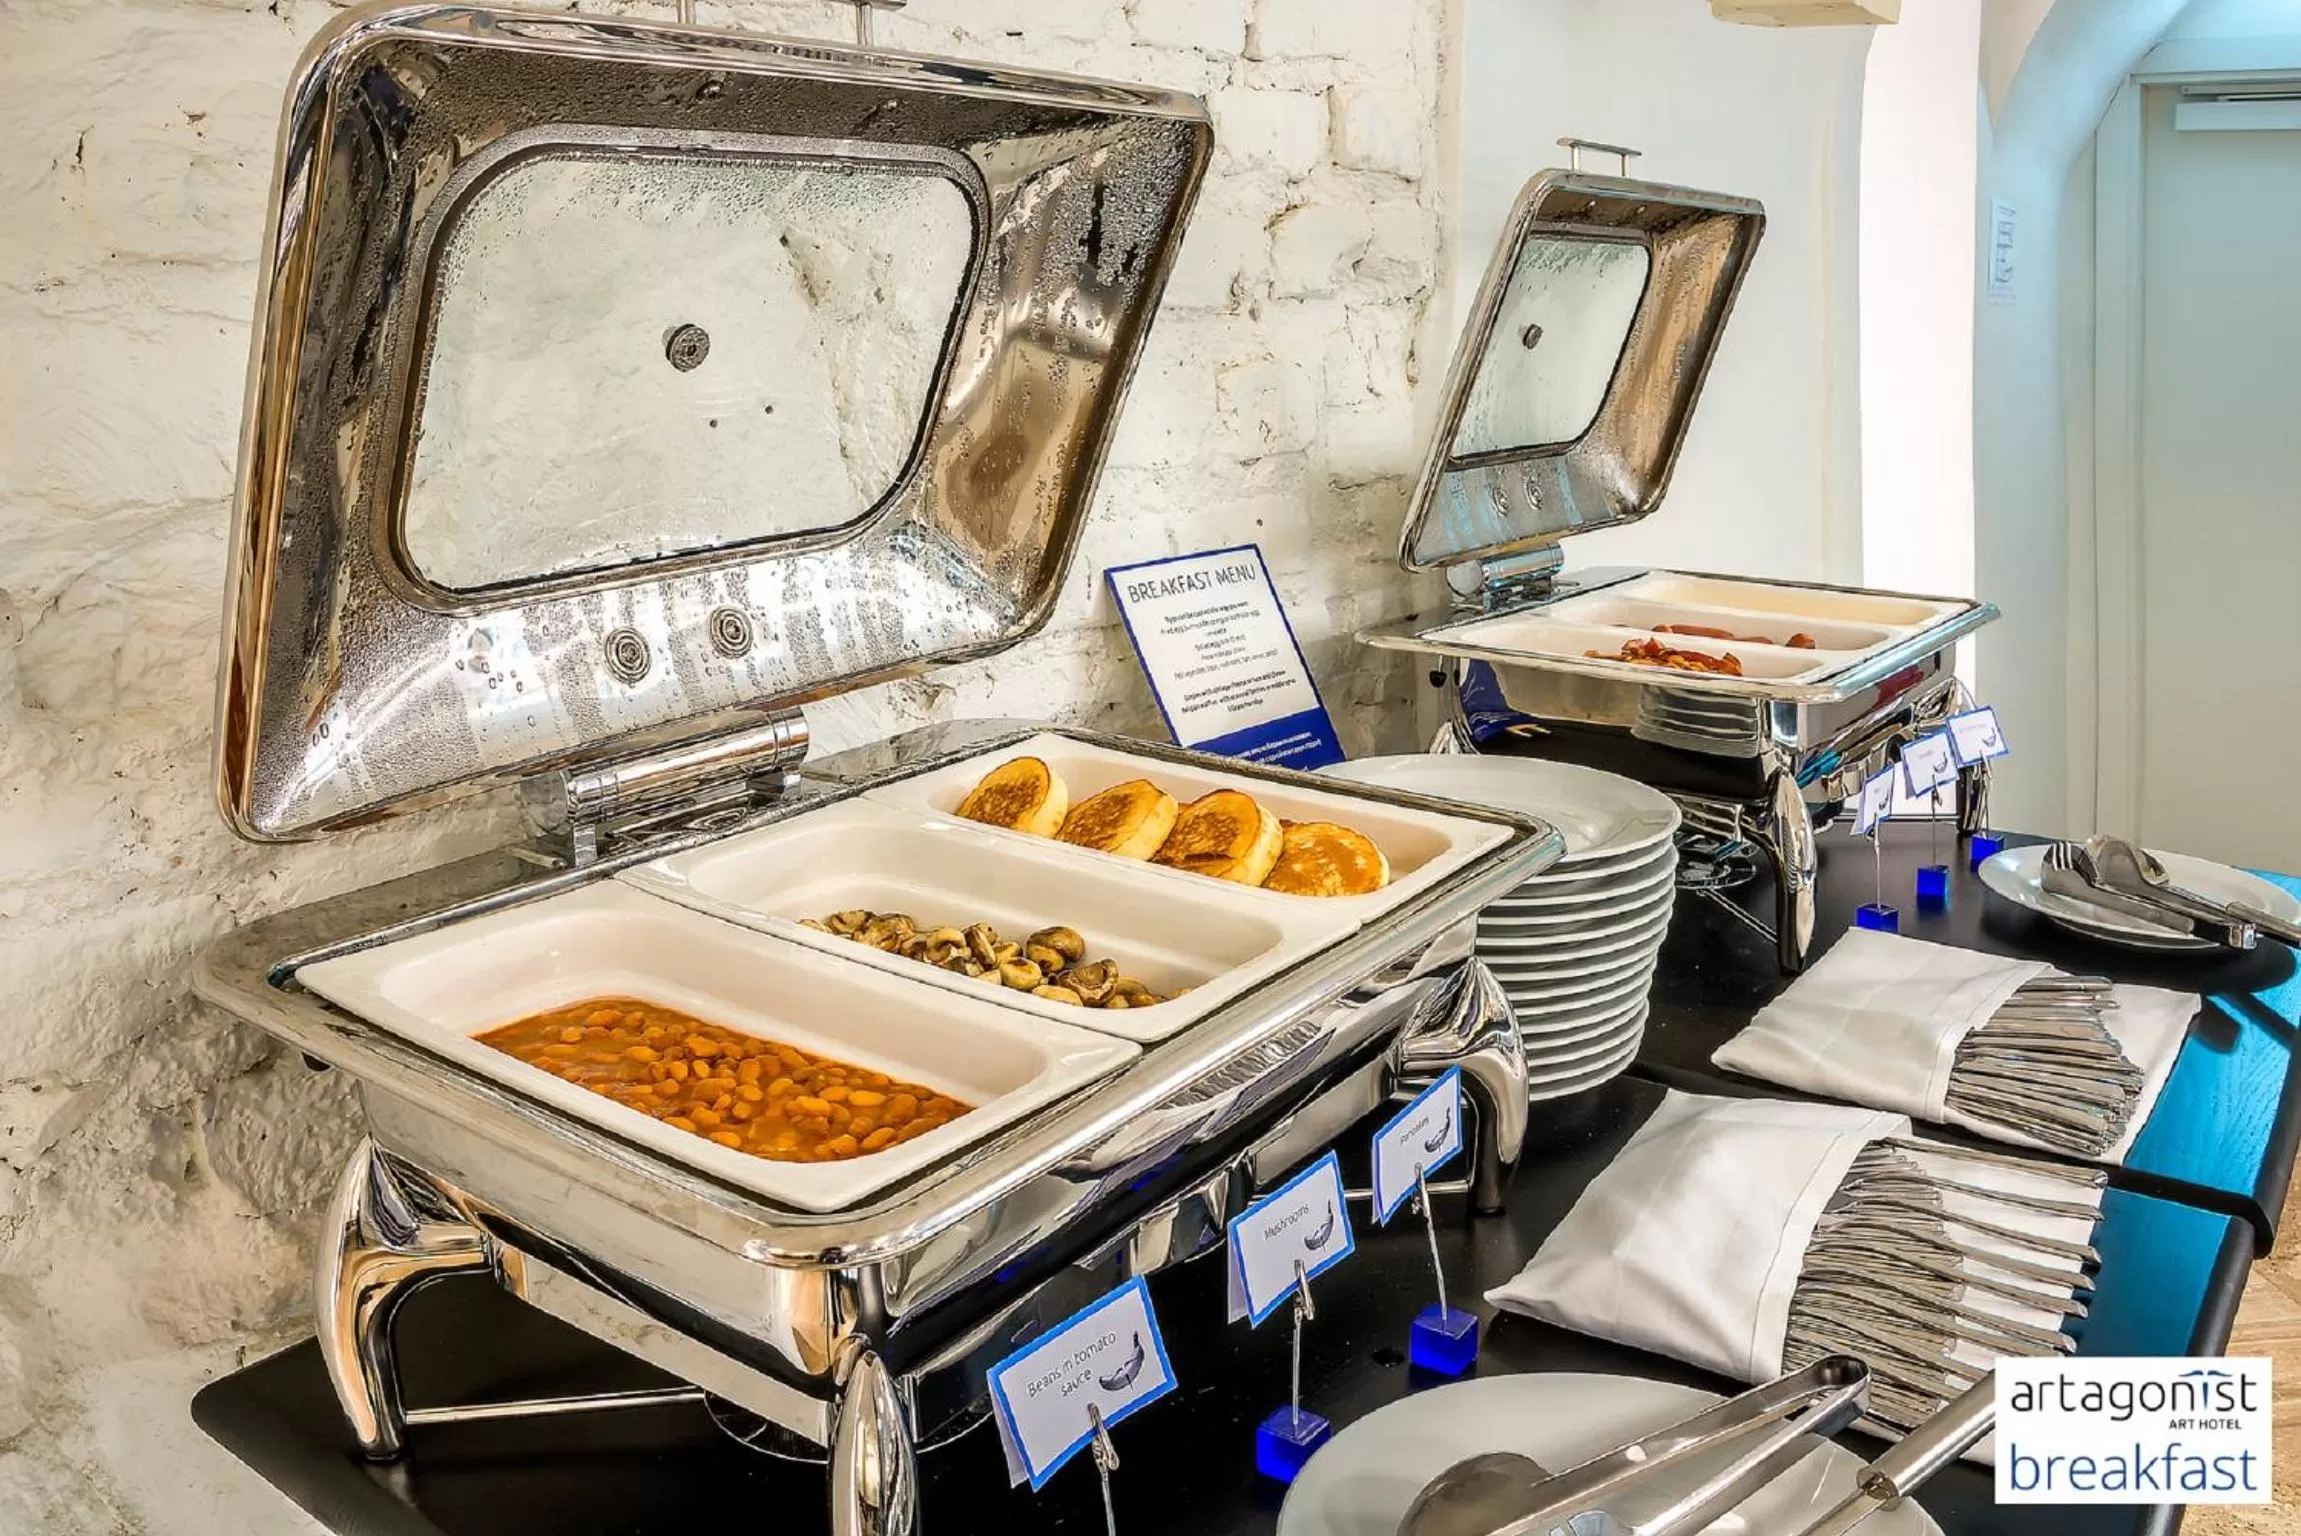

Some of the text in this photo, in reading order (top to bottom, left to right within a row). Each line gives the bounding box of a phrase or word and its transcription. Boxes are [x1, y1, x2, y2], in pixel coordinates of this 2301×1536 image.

[1126, 564, 1256, 604] BREAKFAST MENU
[1026, 1368, 1061, 1398] Beans
[1074, 1332, 1117, 1367] tomato
[1060, 1368, 1093, 1397] sauce
